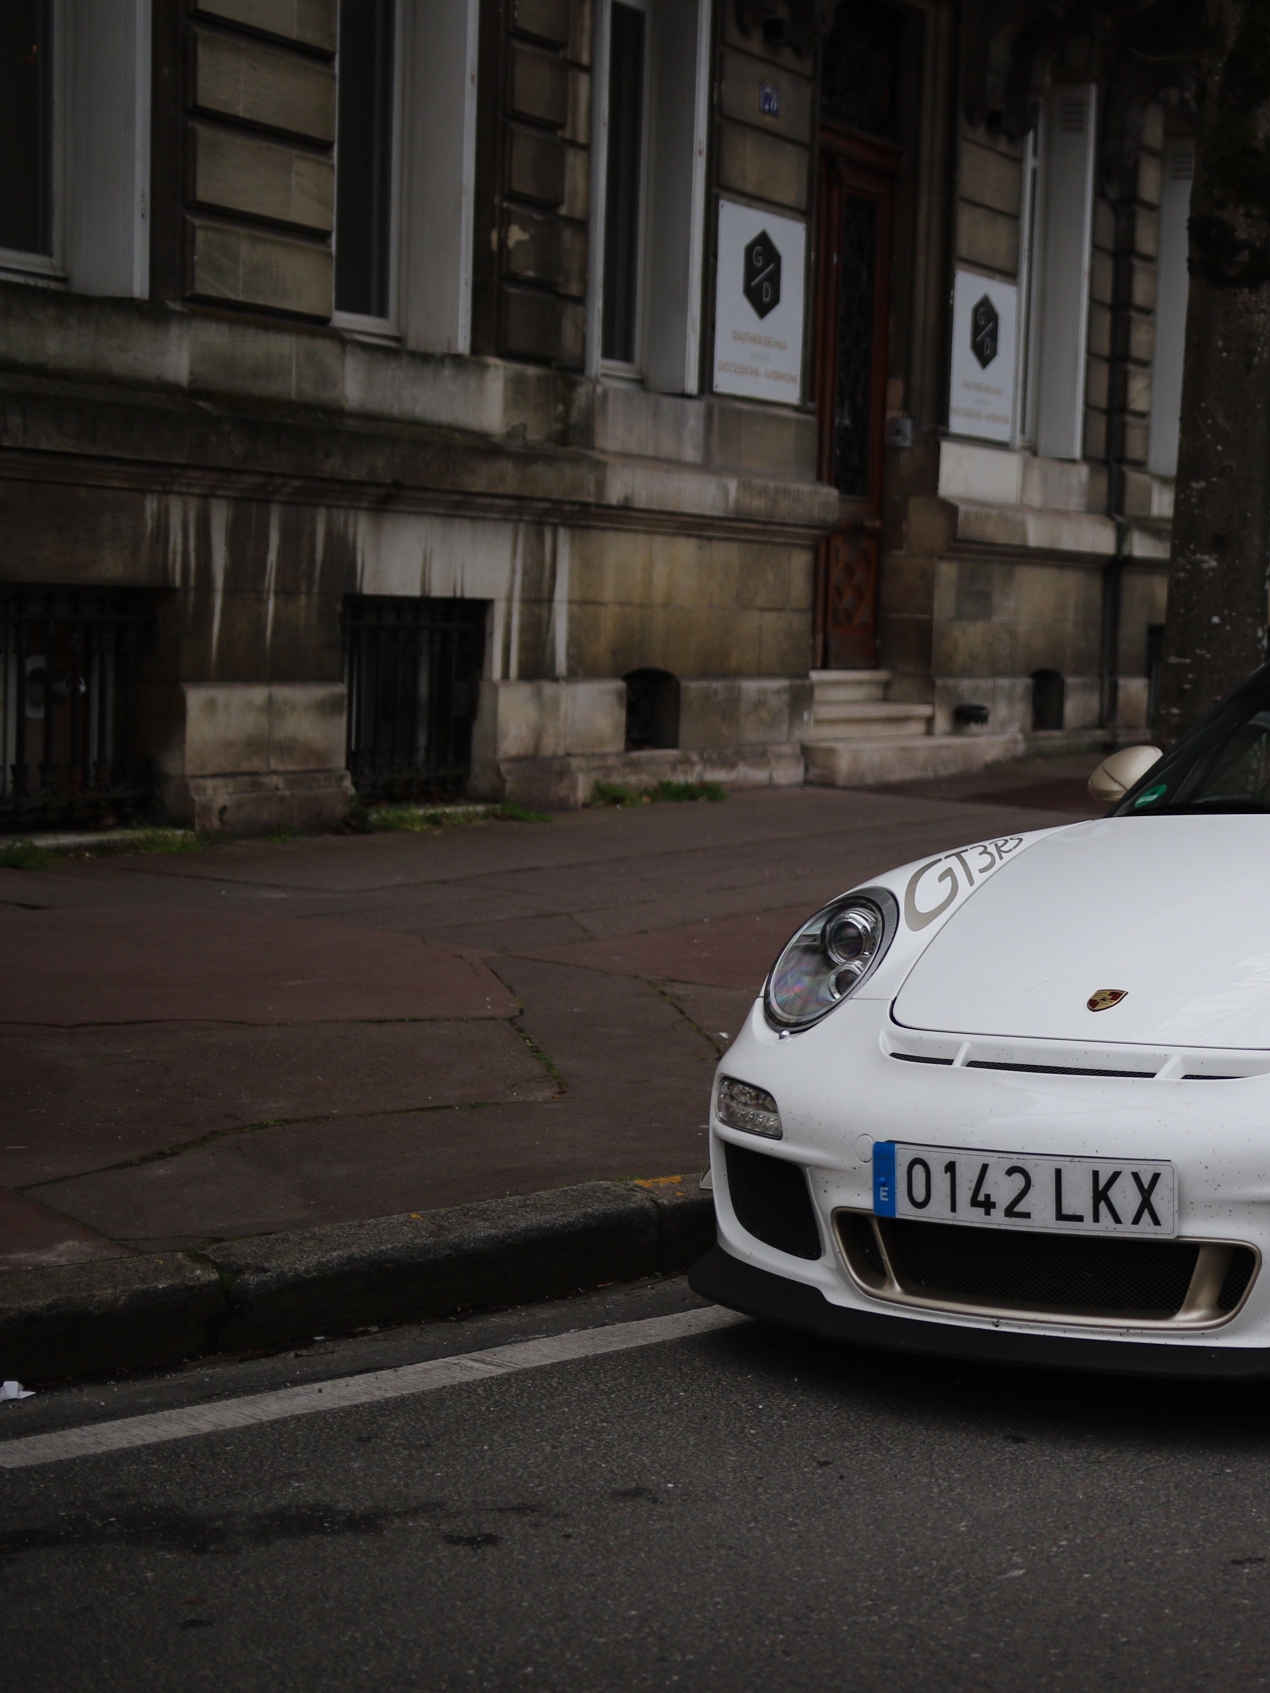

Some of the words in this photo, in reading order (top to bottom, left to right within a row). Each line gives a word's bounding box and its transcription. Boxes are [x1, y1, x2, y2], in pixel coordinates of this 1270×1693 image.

[752, 246, 764, 268] G
[763, 281, 772, 303] D
[880, 1187, 889, 1201] E
[905, 1157, 1032, 1219] 0142
[1054, 1168, 1162, 1226] LKX
